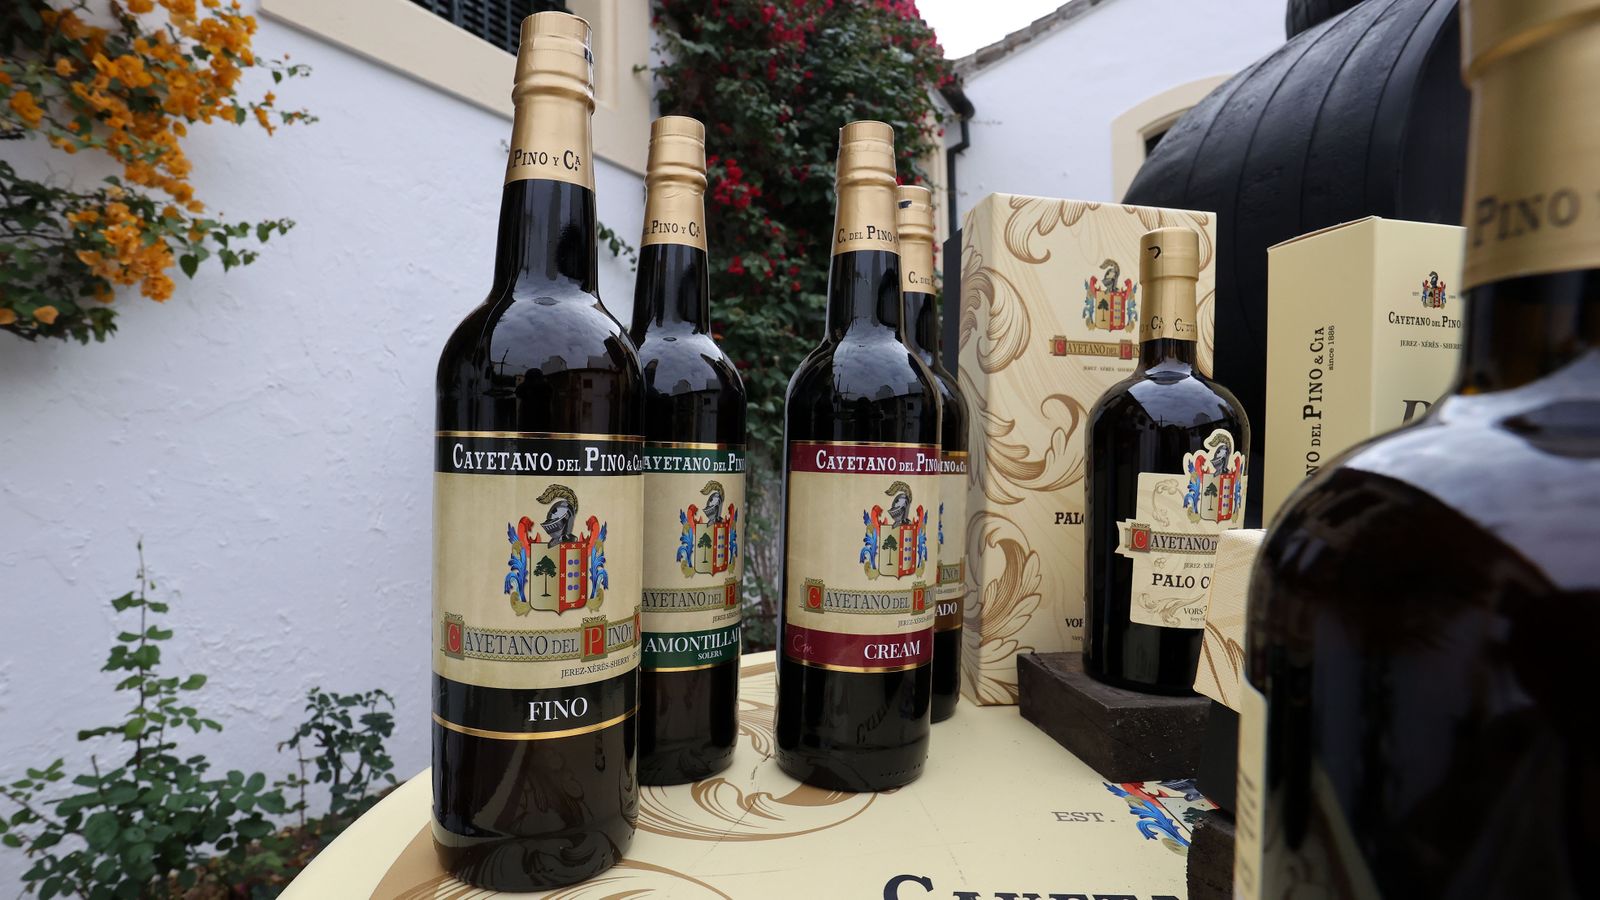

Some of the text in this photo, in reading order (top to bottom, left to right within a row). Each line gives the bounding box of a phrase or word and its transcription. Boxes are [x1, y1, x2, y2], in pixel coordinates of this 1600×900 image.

[512, 149, 548, 168] PINO
[651, 220, 678, 234] PINO
[838, 228, 846, 243] C.
[849, 231, 863, 240] DEL
[867, 225, 892, 242] PINO
[908, 271, 918, 284] C.
[1389, 311, 1430, 326] CAYETANO
[1442, 316, 1461, 328] PINO
[1309, 327, 1324, 353] CIA
[1314, 355, 1323, 364] &
[1303, 368, 1323, 420] PINO
[1312, 424, 1321, 447] DEL
[453, 443, 552, 471] CAYETANO
[557, 459, 580, 472] DEL
[584, 447, 625, 472] PINO
[627, 460, 632, 471] &
[643, 455, 710, 471] AYETANO
[713, 462, 726, 471] DEL
[816, 450, 896, 470] CAYETANO
[899, 462, 914, 472] DEL
[940, 460, 955, 472] INO
[1152, 573, 1195, 589] PALO
[641, 591, 706, 608] AYETANO
[708, 594, 723, 604] DEL
[893, 597, 910, 609] DEL
[552, 638, 579, 655] DEL
[645, 627, 738, 653] AMONTILLA
[864, 640, 920, 660] CREAM
[528, 697, 588, 722] FINO
[1051, 811, 1116, 823] EST.
